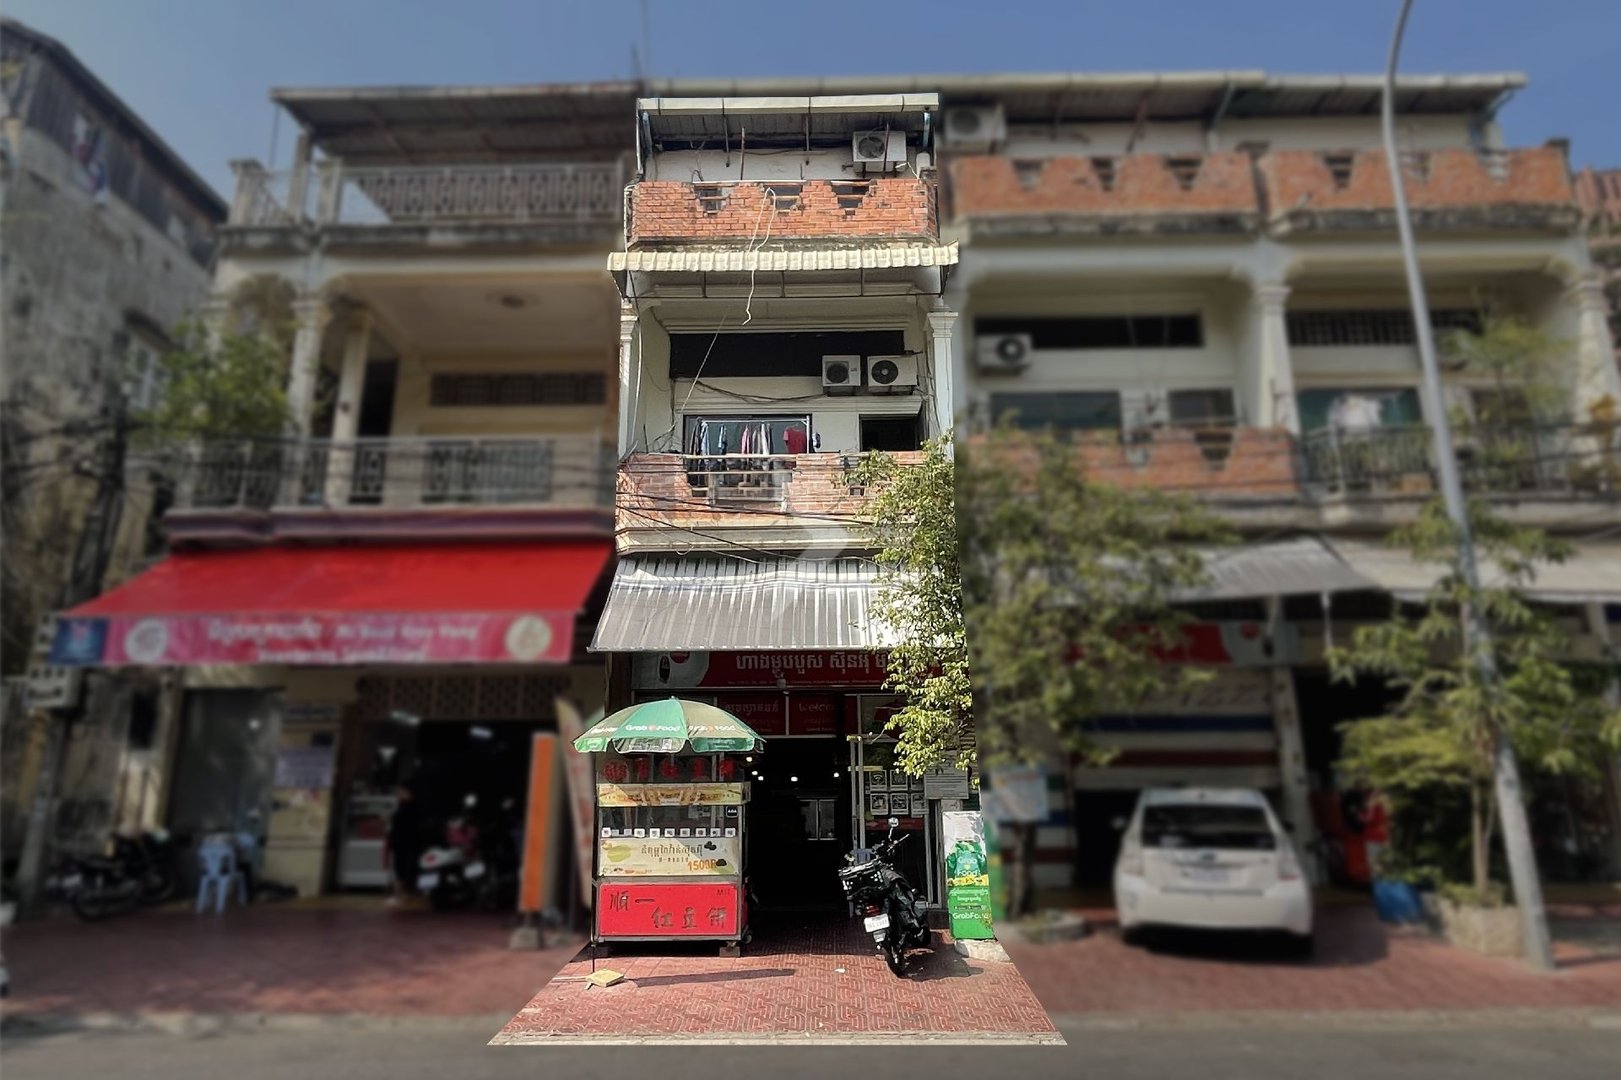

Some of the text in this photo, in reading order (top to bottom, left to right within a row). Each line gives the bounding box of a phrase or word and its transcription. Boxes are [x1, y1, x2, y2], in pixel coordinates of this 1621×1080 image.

[625, 724, 647, 732] Grab
[656, 725, 681, 733] Food
[957, 855, 978, 865] Grab
[957, 869, 979, 878] Food
